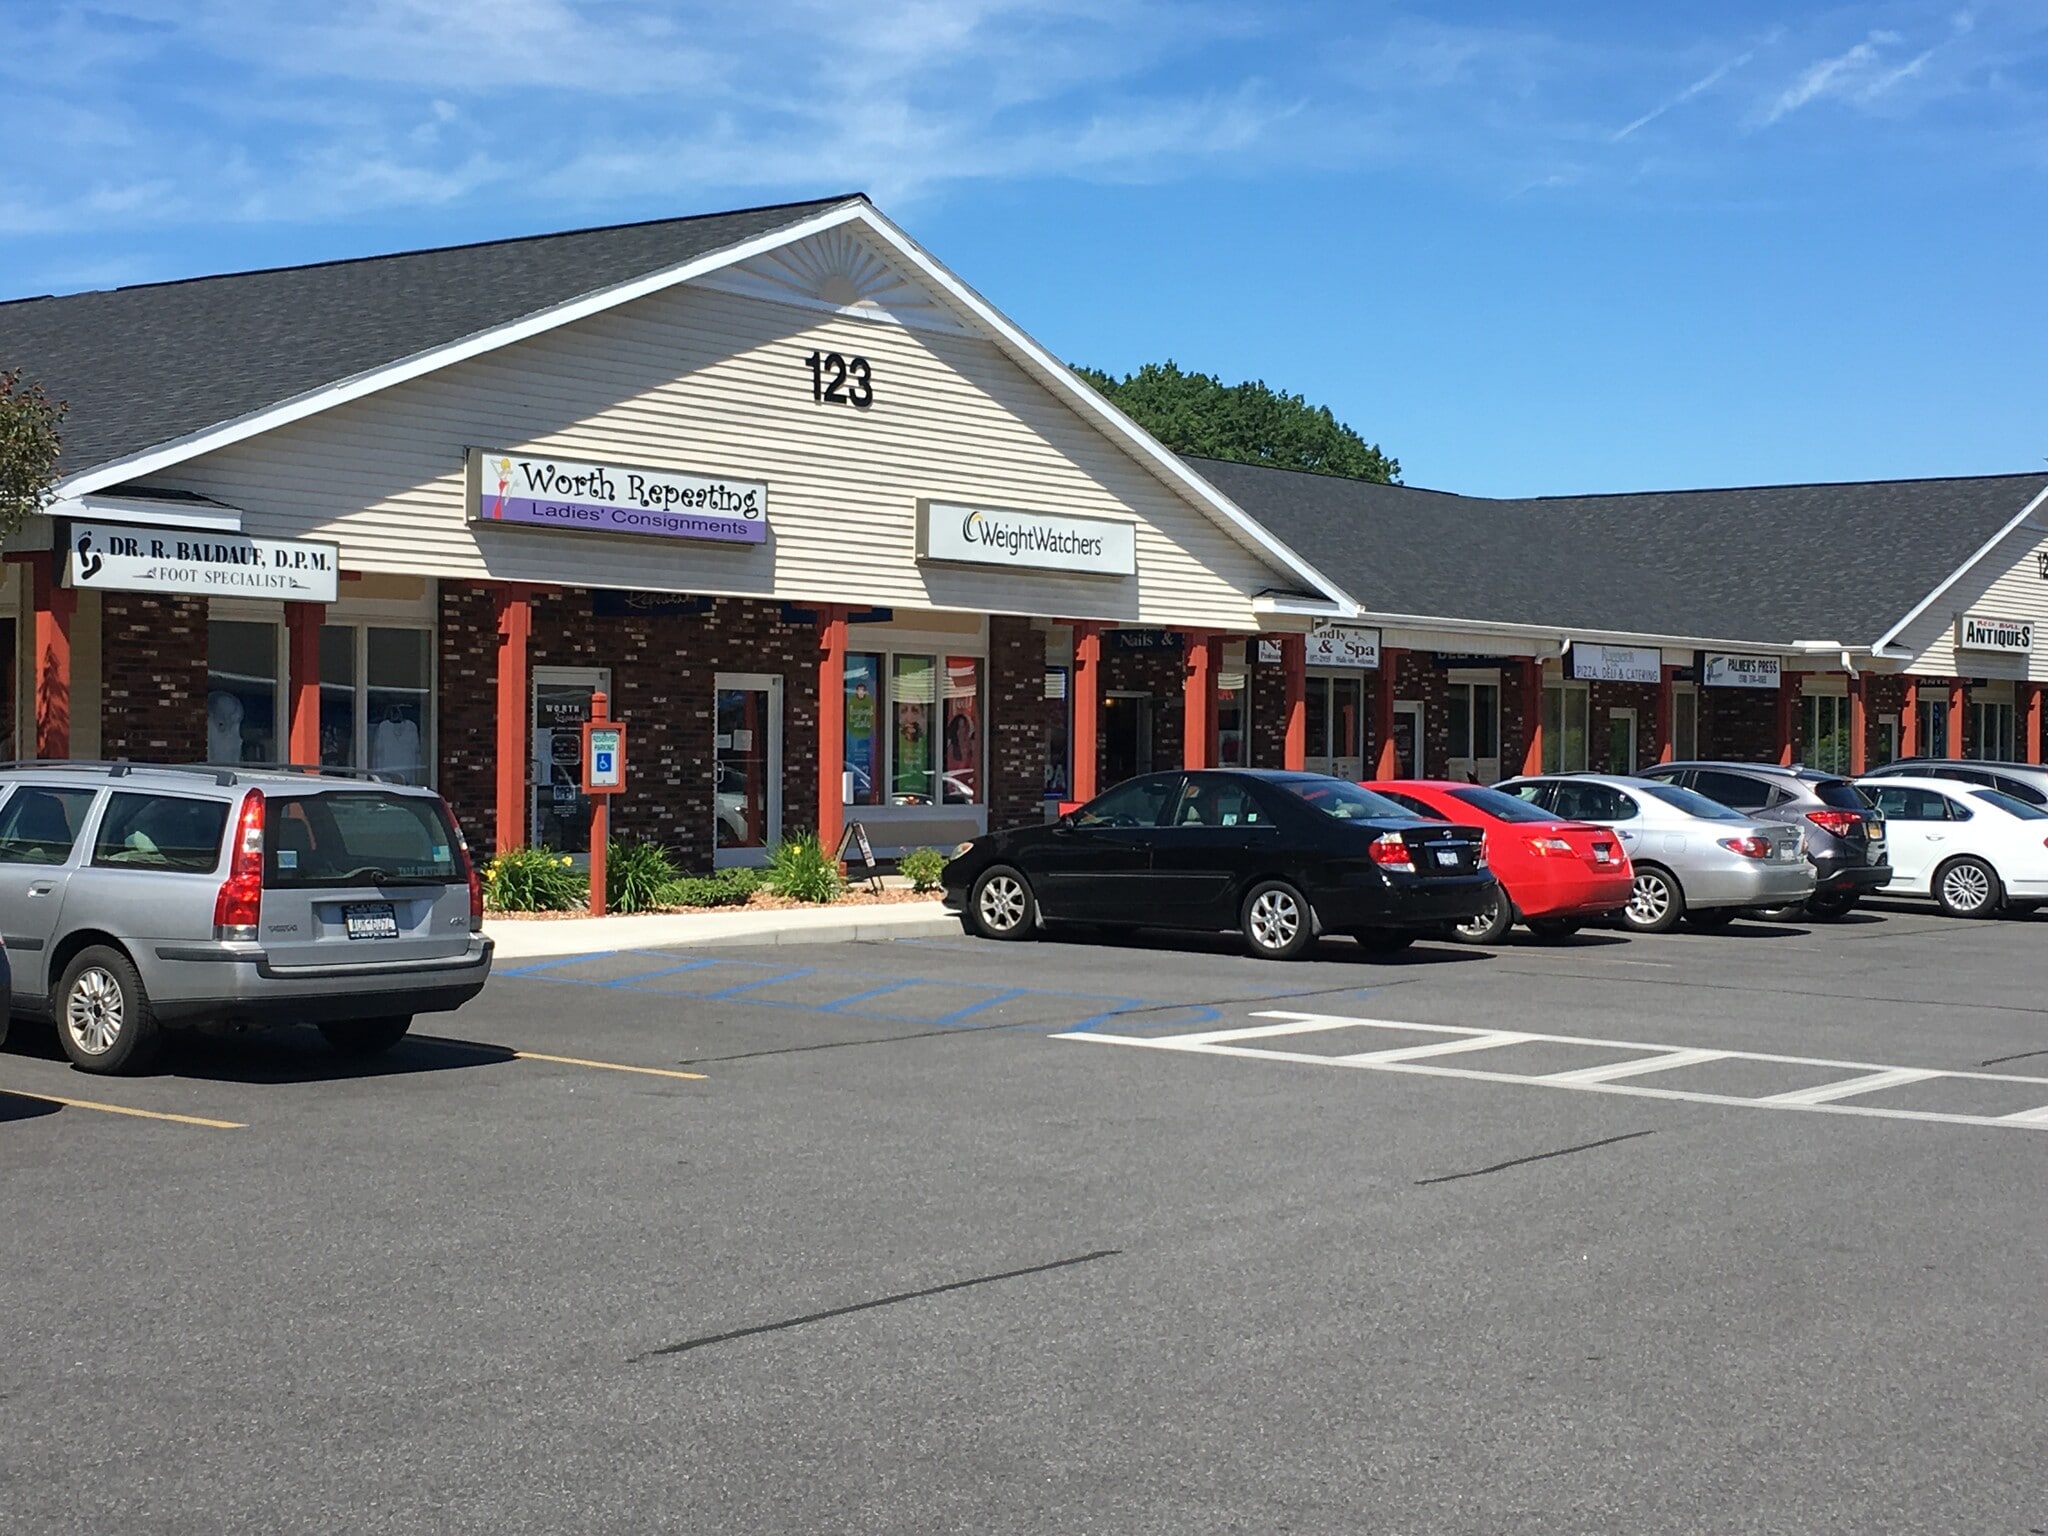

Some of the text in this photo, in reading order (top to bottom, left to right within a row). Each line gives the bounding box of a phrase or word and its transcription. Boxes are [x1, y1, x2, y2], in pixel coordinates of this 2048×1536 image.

[805, 351, 873, 408] 123
[518, 462, 760, 520] Worth Repeating
[531, 502, 748, 536] Ladies' Consignments
[978, 519, 1103, 557] WeightWatchers
[109, 536, 332, 572] DR. R. BALDAUF, D.P.M.
[159, 566, 288, 589] FOOT SPECIALIST
[1120, 632, 1175, 648] Nails &
[1966, 620, 2031, 649] ANTIQUES
[1318, 639, 1334, 654] &
[1344, 640, 1376, 659] Spa
[1602, 666, 1617, 679] DELI
[1626, 668, 1658, 681] CATERING
[1727, 658, 1778, 674] PALMER'S PRESS
[545, 704, 580, 713] WORTH
[594, 743, 615, 751] PARKING
